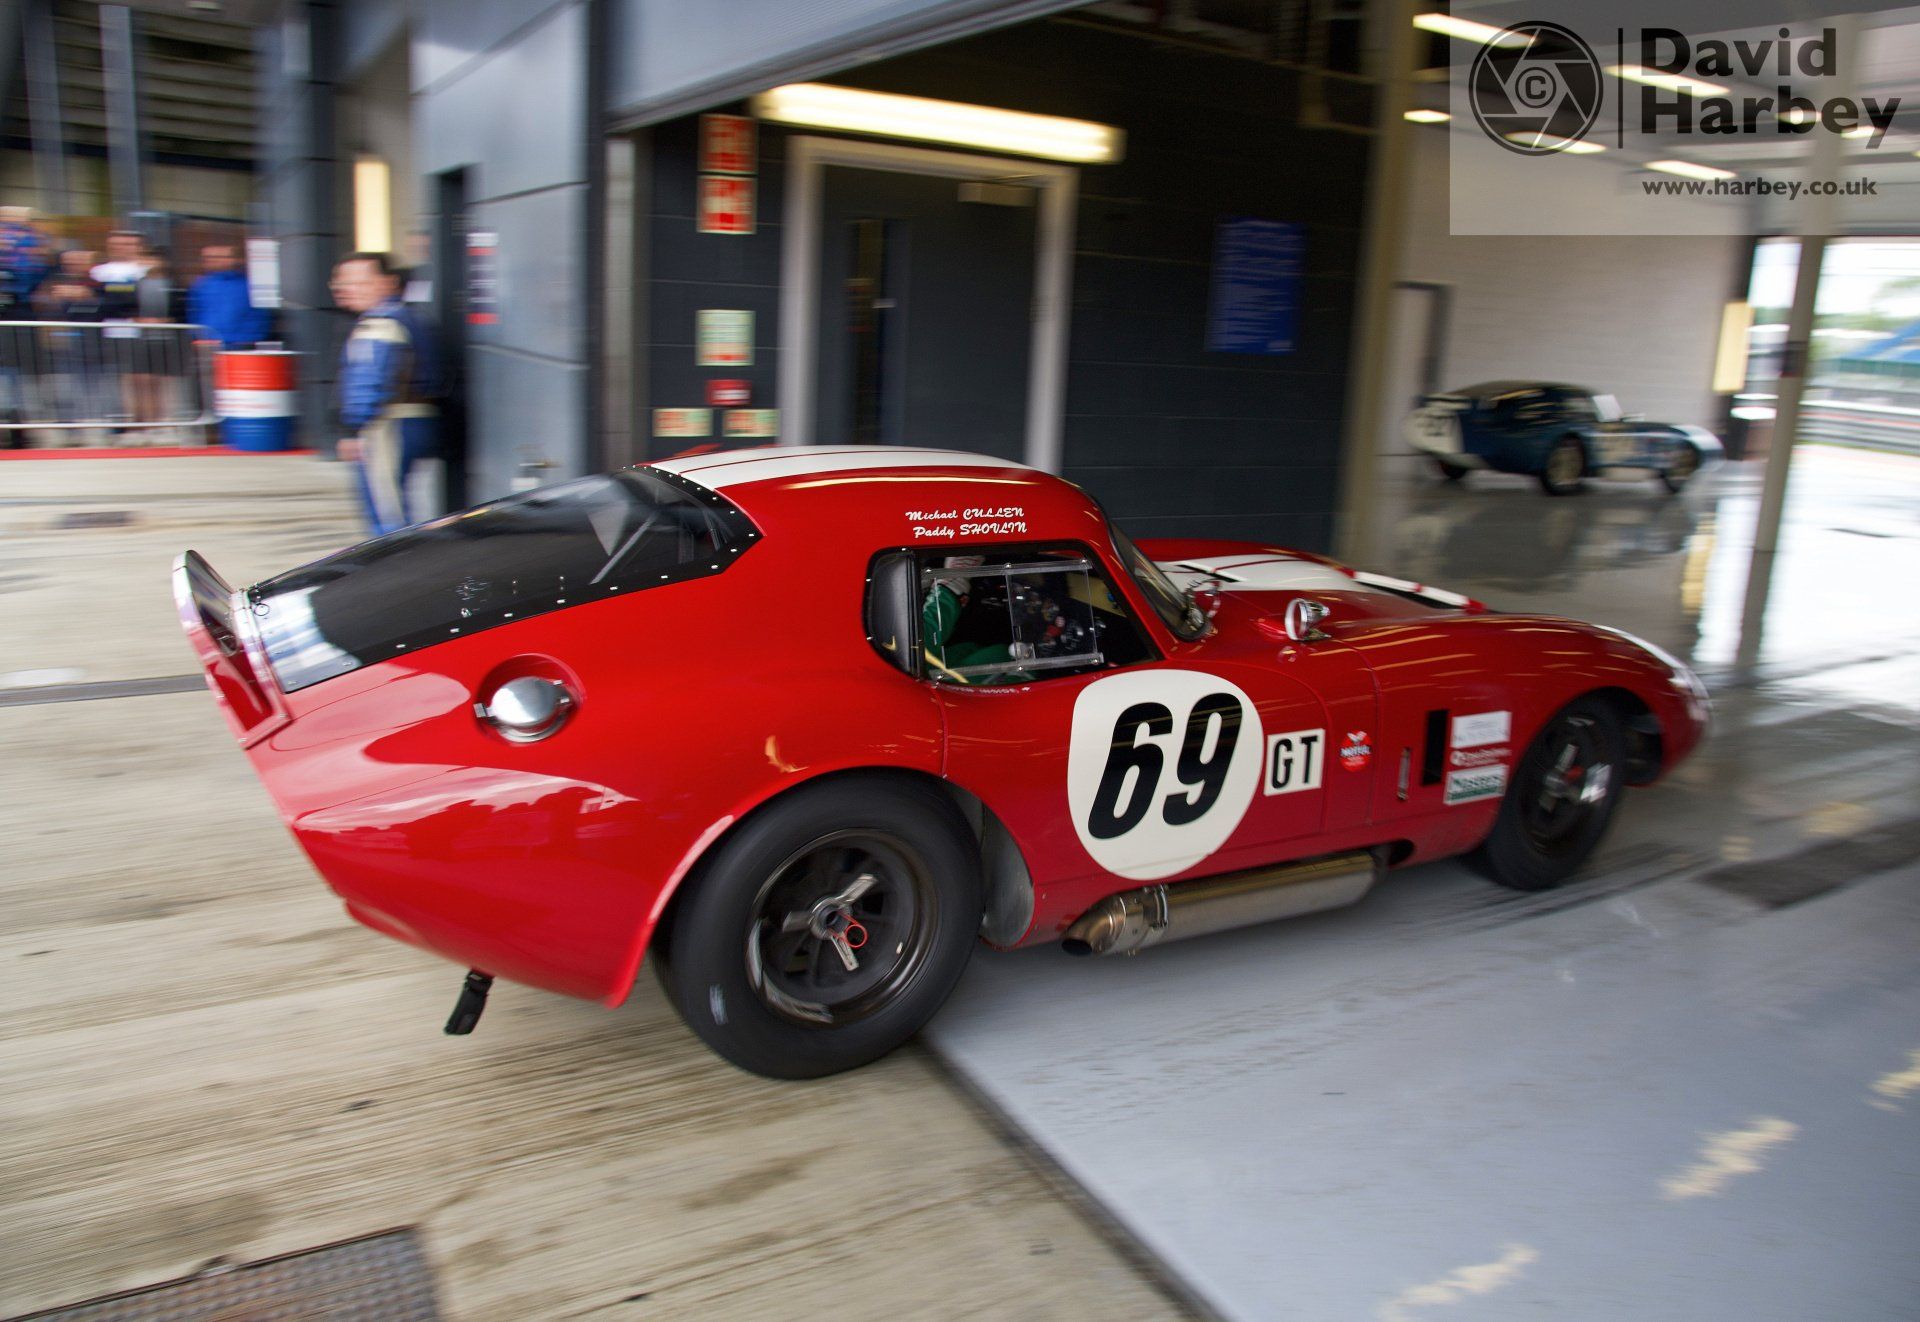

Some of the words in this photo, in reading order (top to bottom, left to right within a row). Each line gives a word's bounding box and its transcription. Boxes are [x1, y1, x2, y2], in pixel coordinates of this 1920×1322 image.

[904, 510, 959, 521] Michael
[962, 507, 1025, 520] CULLEN
[912, 526, 956, 539] Paddy
[959, 521, 1028, 536] SHOVLIN
[1087, 692, 1243, 840] 69
[1270, 735, 1319, 790] GT
